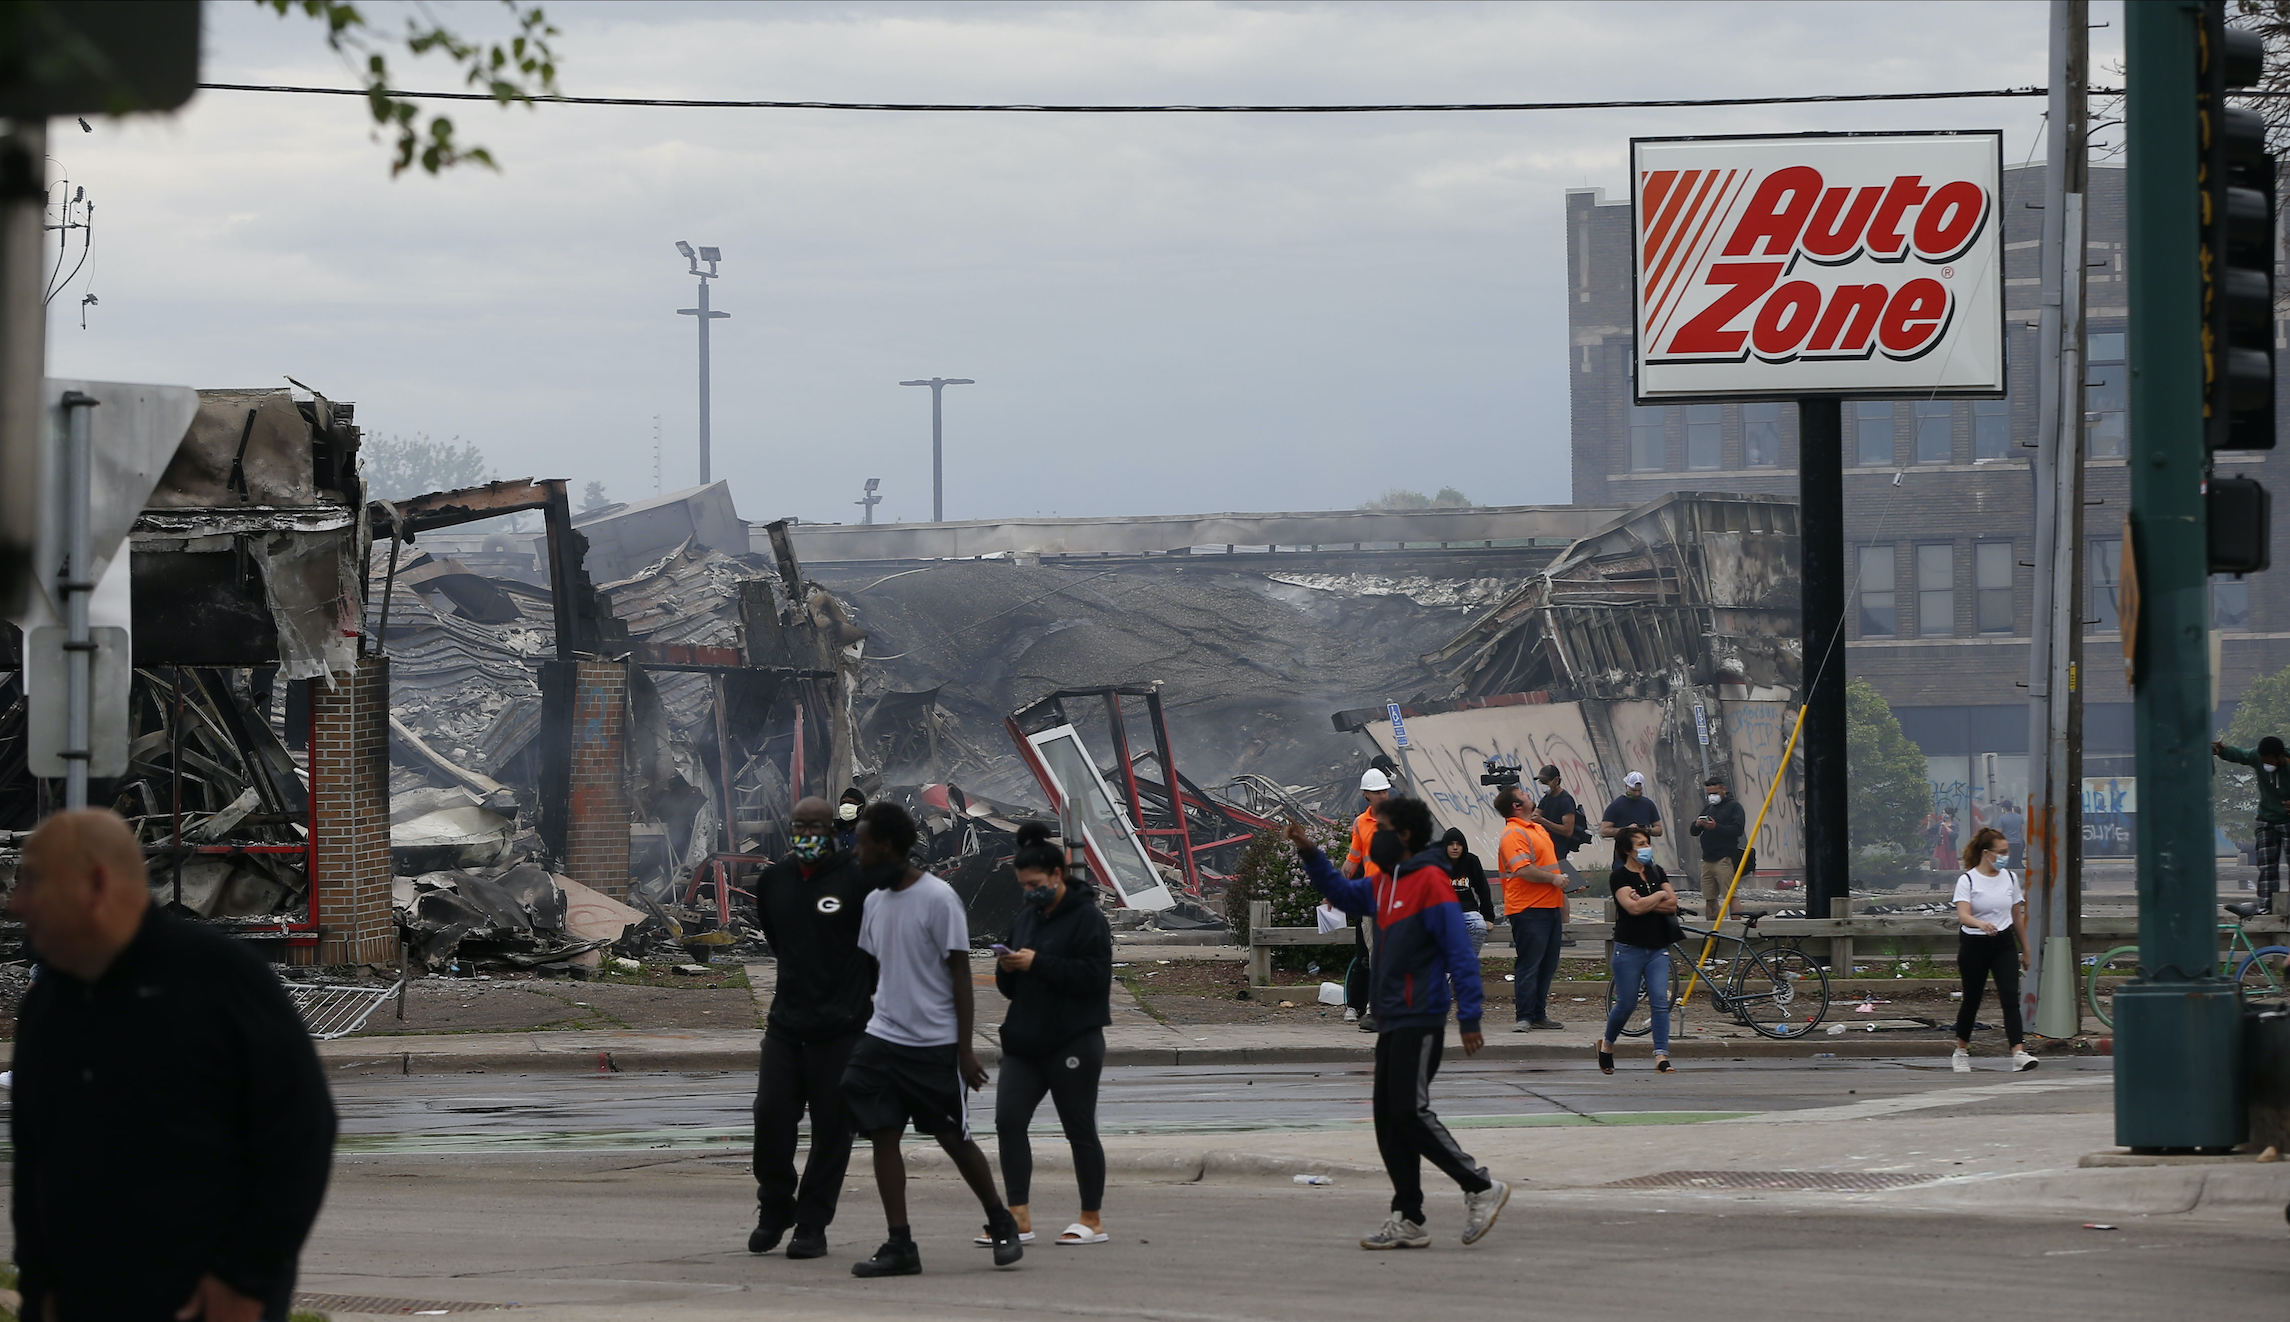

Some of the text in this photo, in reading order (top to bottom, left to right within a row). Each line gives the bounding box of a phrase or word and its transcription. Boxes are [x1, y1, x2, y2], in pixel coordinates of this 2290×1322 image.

[1720, 165, 1987, 263] Auto
[1665, 262, 1952, 361] Zone
[817, 896, 841, 913] G
